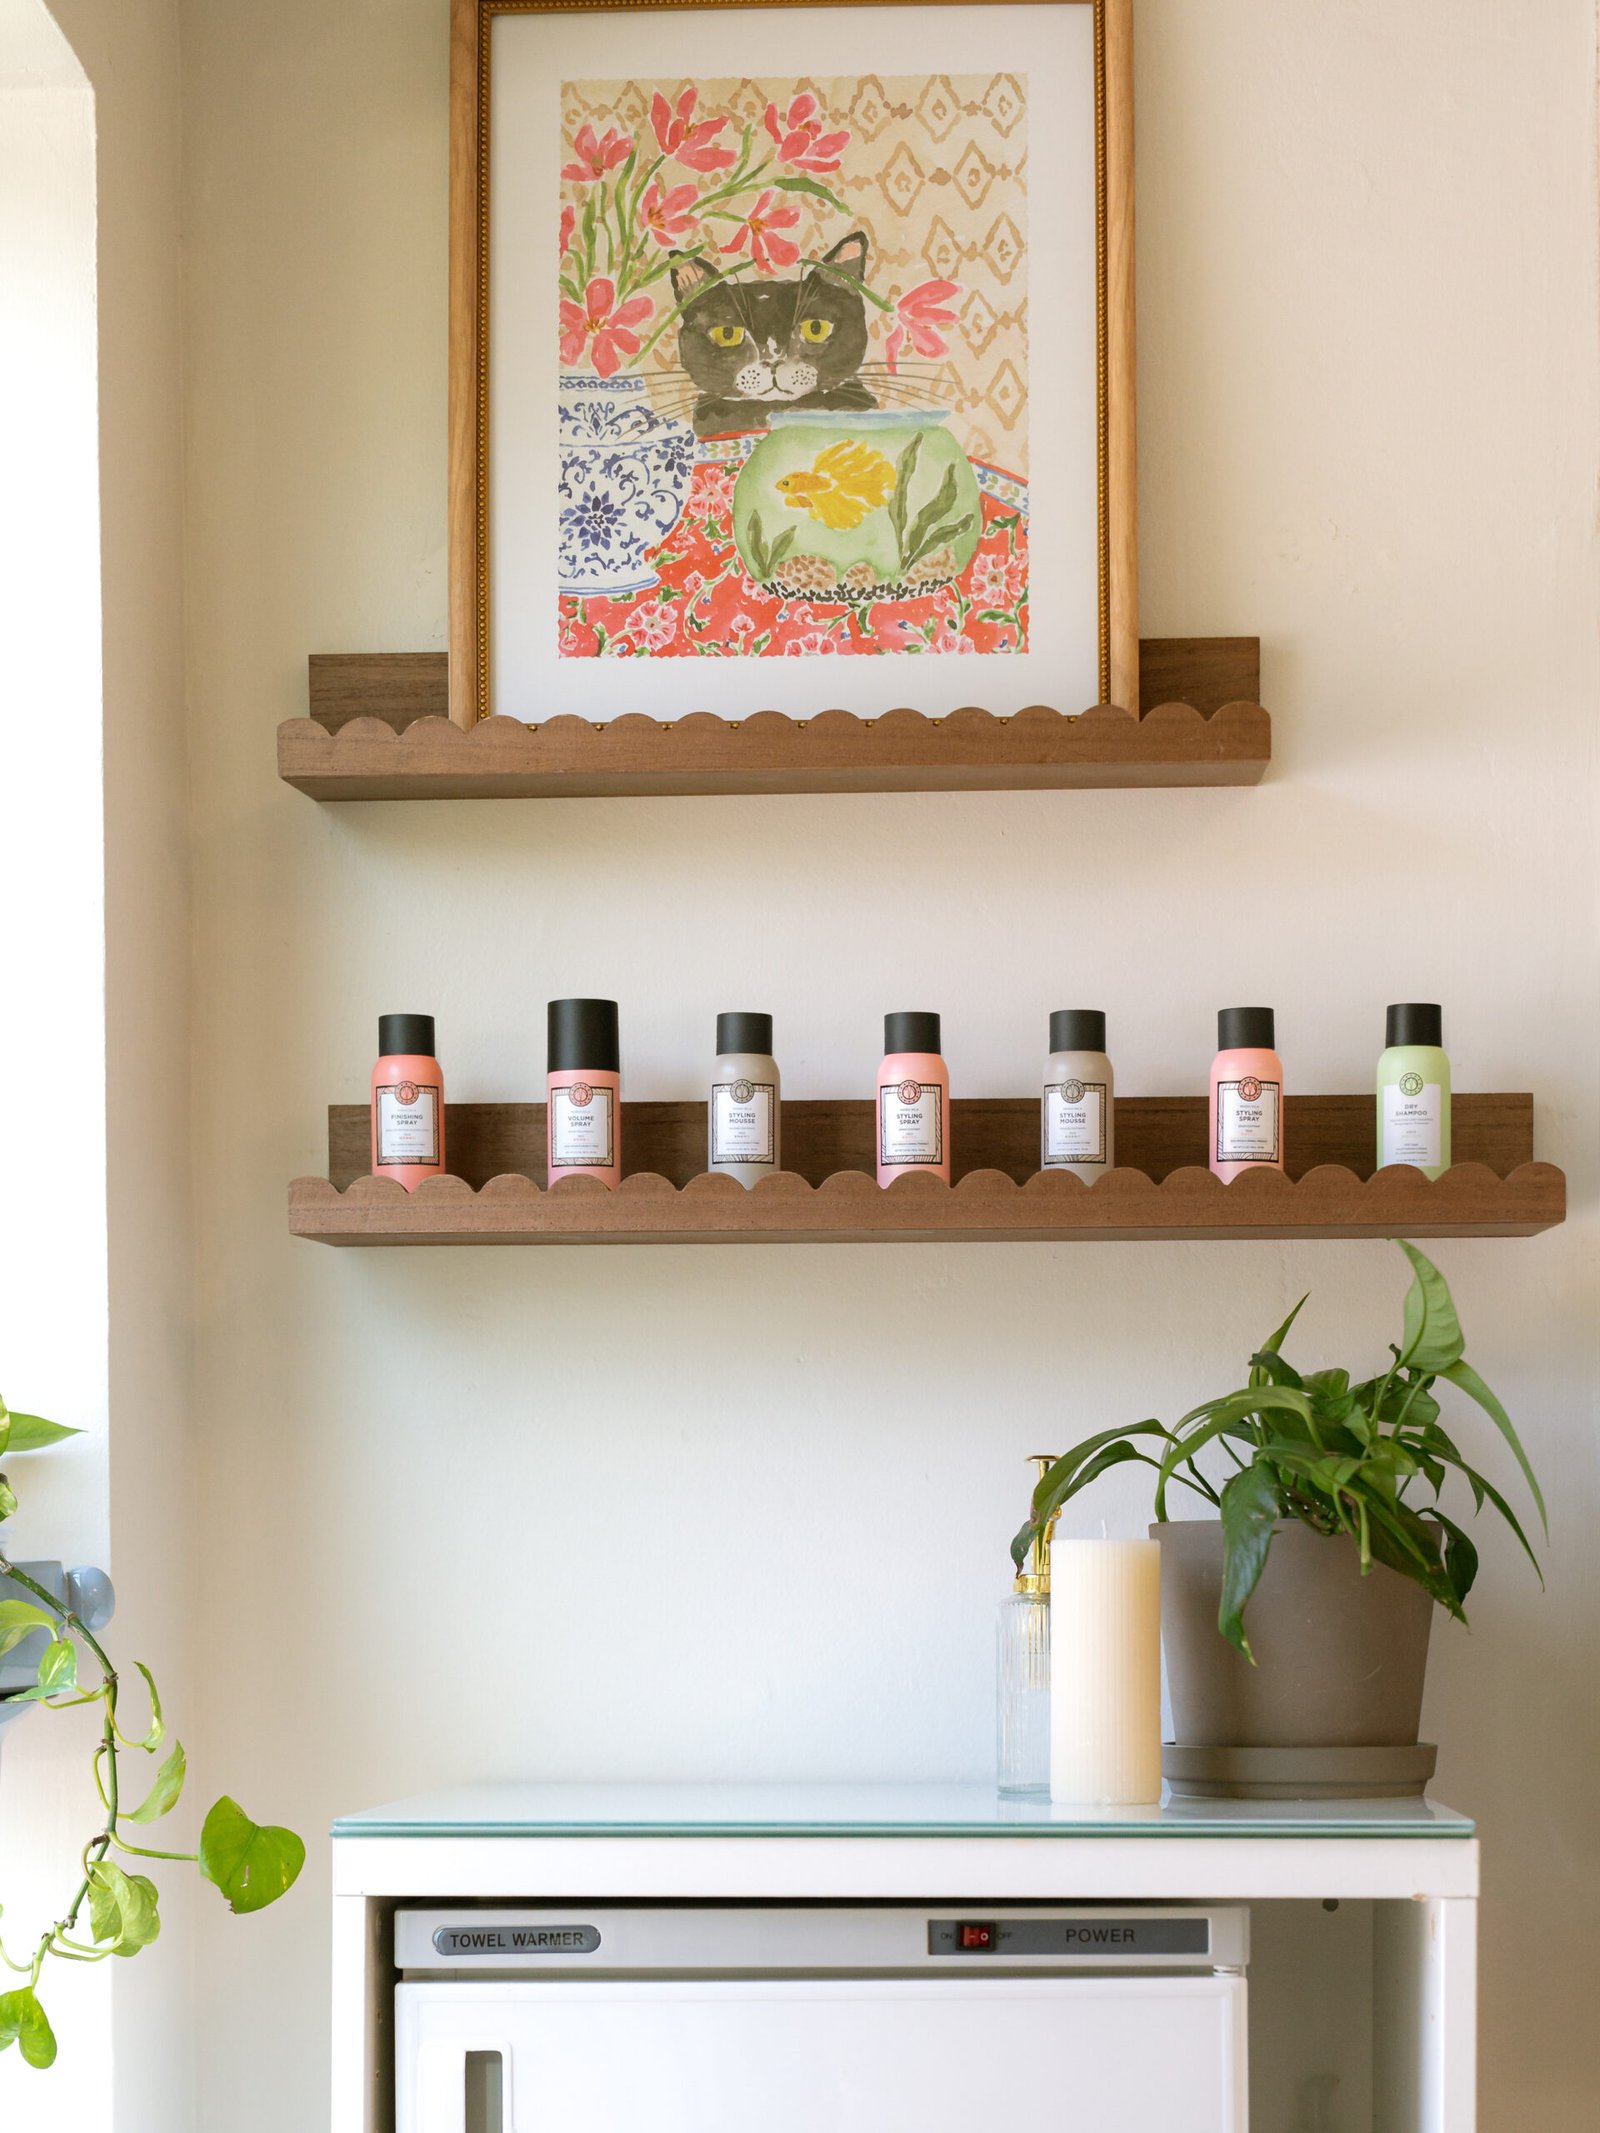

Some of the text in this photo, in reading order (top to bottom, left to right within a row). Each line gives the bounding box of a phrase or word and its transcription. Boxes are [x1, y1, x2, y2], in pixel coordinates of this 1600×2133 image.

[451, 1932, 584, 1948] TOWEL WARMER
[1066, 1928, 1135, 1943] POWER
